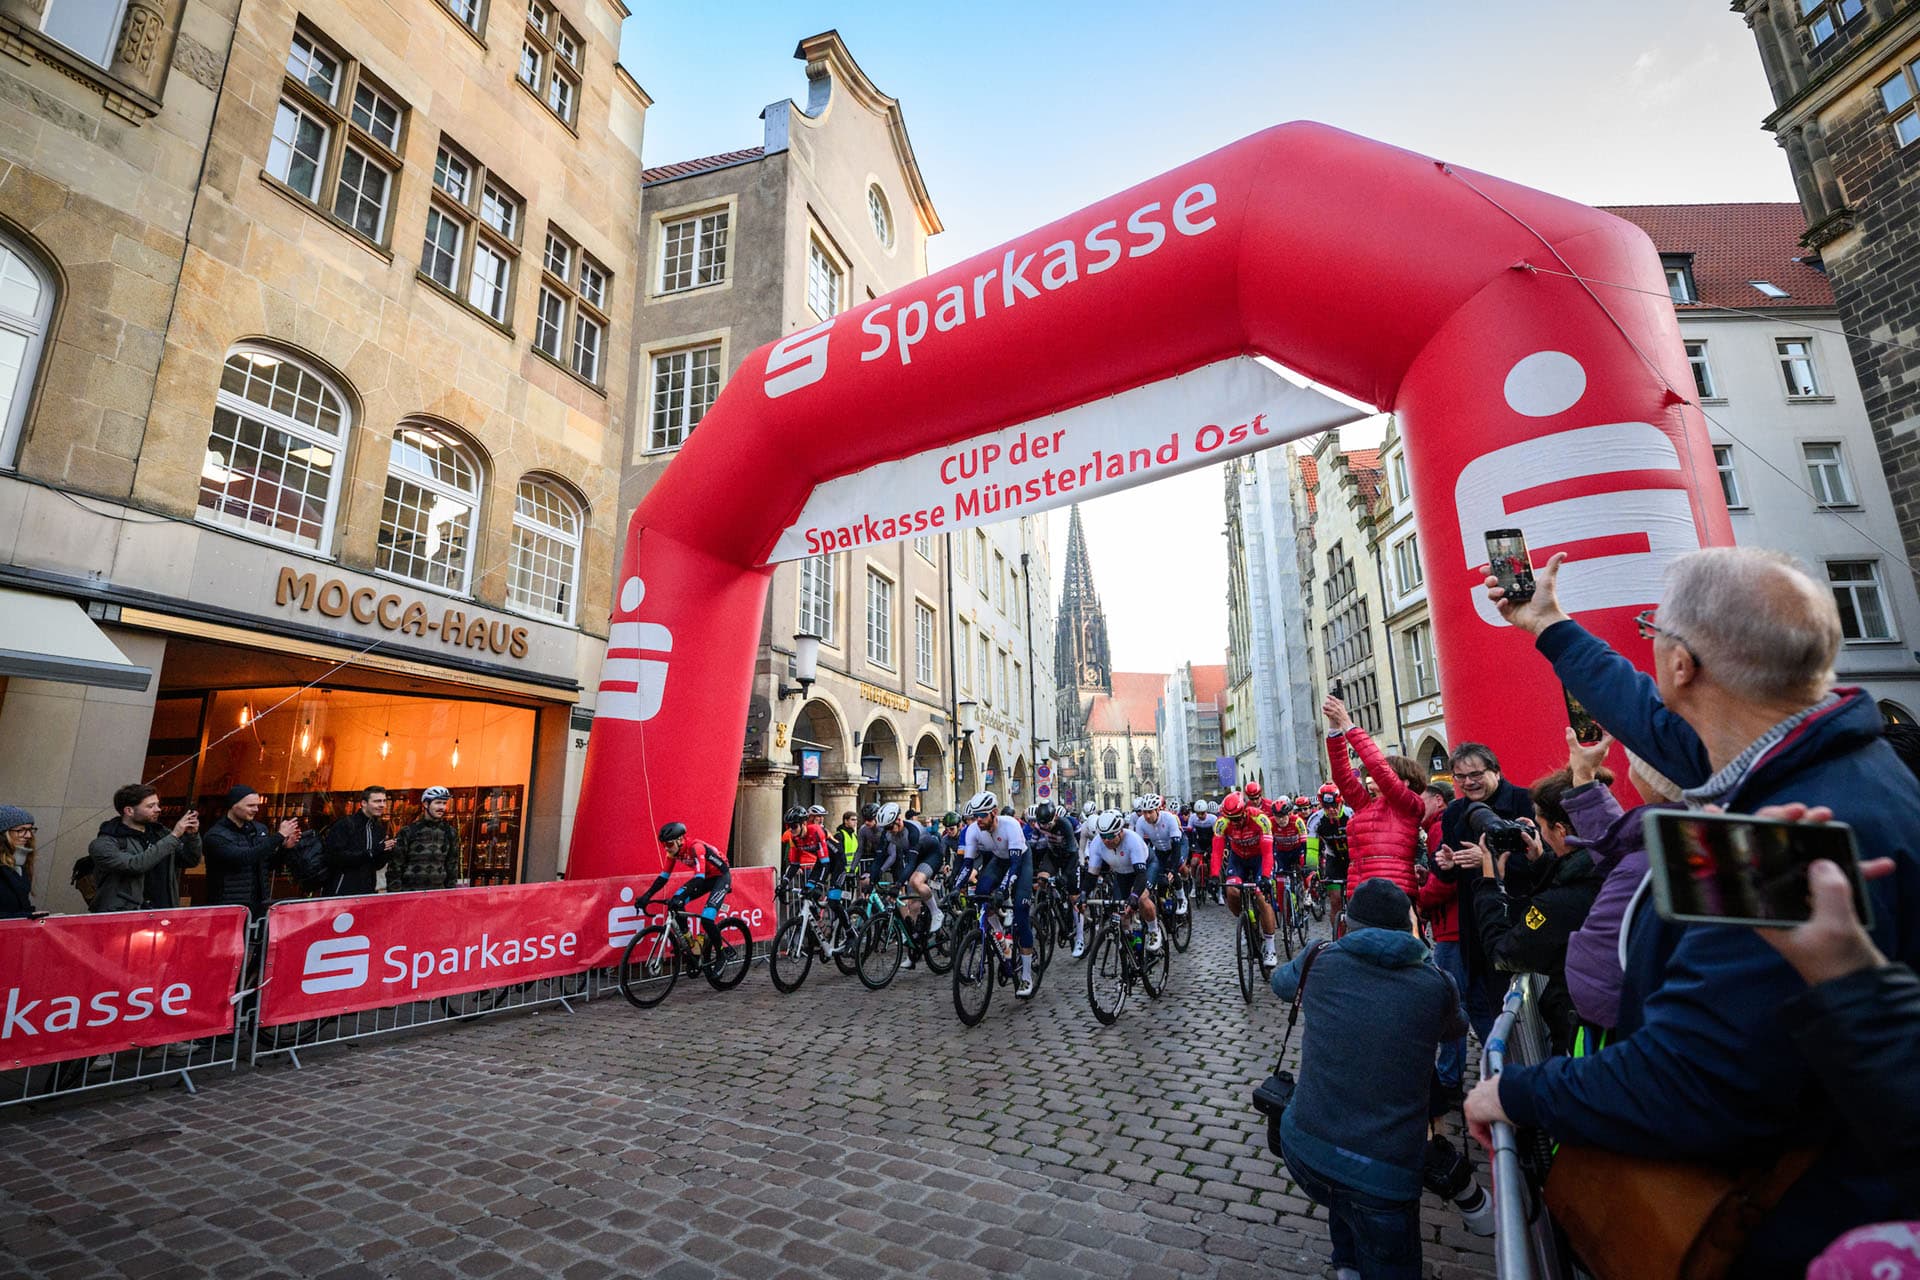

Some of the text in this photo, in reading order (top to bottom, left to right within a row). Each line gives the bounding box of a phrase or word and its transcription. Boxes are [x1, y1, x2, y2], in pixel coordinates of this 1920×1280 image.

[860, 182, 1218, 366] Sparkasse
[940, 429, 1066, 485] CUP der
[804, 415, 1269, 556] Sparkasse Münsterland Ost
[275, 566, 529, 659] MOCCA-HAUS
[575, 737, 589, 749] 53-
[651, 908, 763, 948] Sarasse
[382, 932, 577, 989] Sparkasse
[1, 983, 192, 1039] kasse
